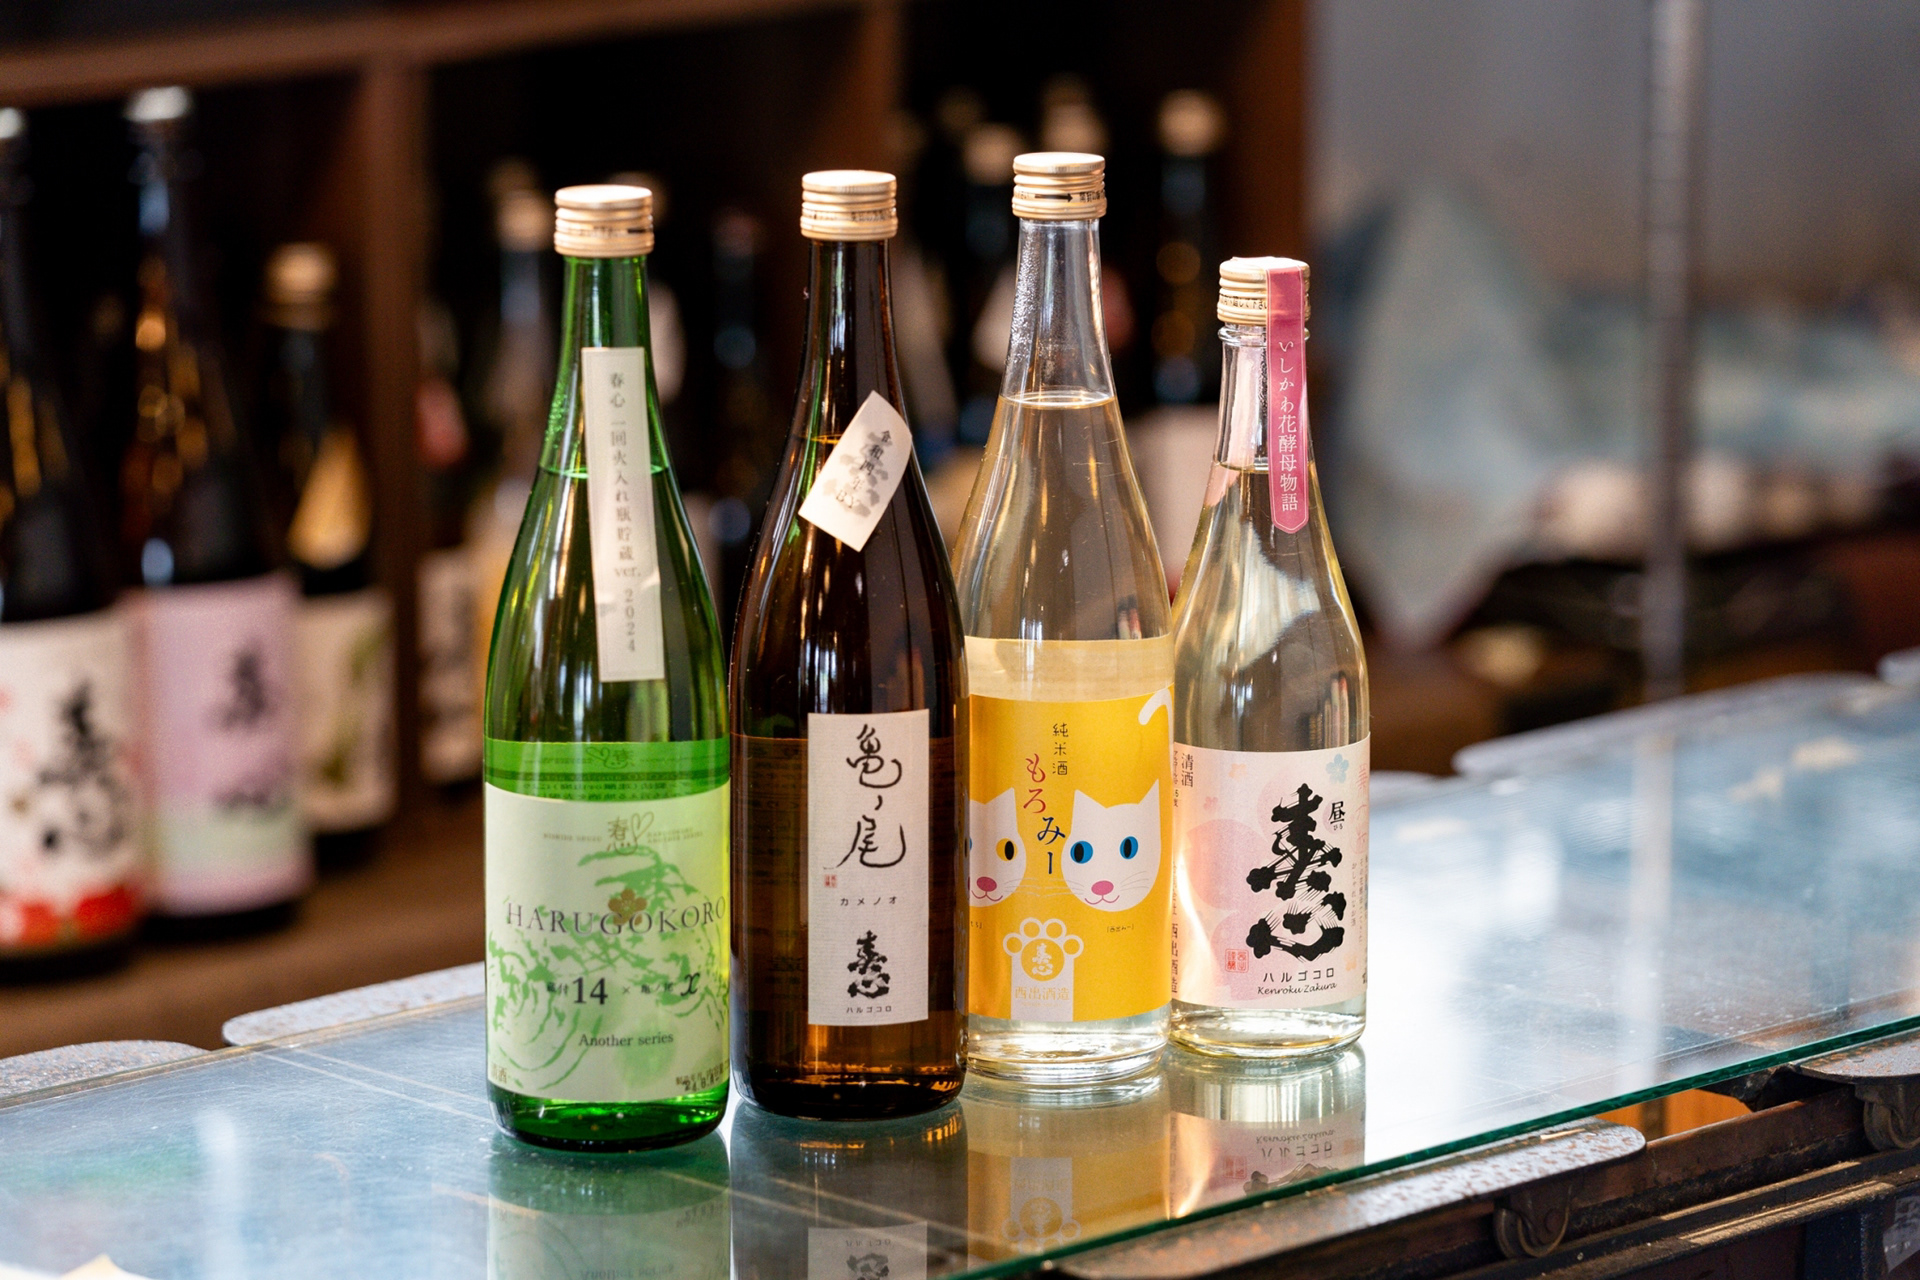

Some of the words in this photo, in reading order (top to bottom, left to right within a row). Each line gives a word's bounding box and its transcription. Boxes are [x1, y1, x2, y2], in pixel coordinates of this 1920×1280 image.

[1278, 341, 1298, 511] いしかわ花酵母物語
[610, 421, 633, 560] 一回火入れ瓶貯蔵
[625, 588, 636, 652] 2024
[1052, 722, 1069, 776] 純米酒
[1181, 753, 1194, 788] 清酒
[1023, 753, 1066, 874] もろみー
[1328, 800, 1346, 824] 昼
[840, 896, 897, 907] カメノオ
[507, 898, 727, 937] HARUGOKORO
[1263, 967, 1335, 983] ハルゴコロ
[572, 976, 609, 1005] 14
[1015, 986, 1070, 1001] 西出酒造
[1257, 984, 1302, 995] Kenroku
[1303, 982, 1337, 994] Zakura
[846, 1005, 892, 1014] ハルゴコロ
[578, 1033, 634, 1047] Another
[638, 1031, 674, 1045] series
